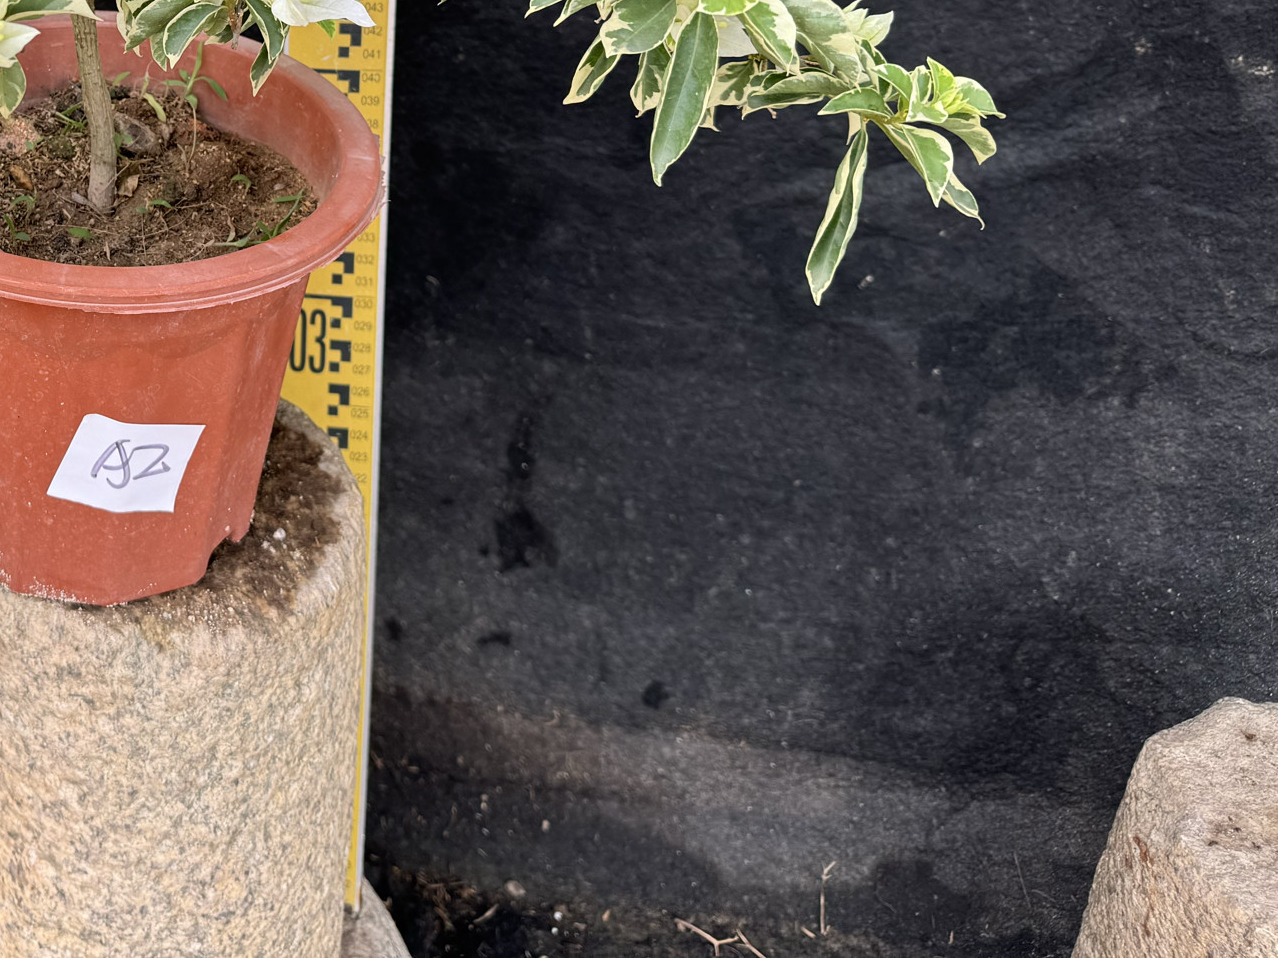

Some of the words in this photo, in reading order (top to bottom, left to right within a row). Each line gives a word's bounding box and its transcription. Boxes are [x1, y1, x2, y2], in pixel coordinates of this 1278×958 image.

[365, 2, 384, 13] 043
[363, 25, 383, 36] 042
[362, 49, 381, 59] 041
[361, 72, 381, 83] 040
[361, 96, 380, 106] 039
[355, 254, 374, 264] 032
[355, 276, 373, 286] 031
[354, 298, 373, 309] 030
[354, 320, 372, 330] 029
[290, 309, 326, 373] 03
[352, 343, 371, 353] 028
[352, 364, 370, 375] 027
[351, 386, 370, 396] 026
[350, 408, 369, 418] 025
[350, 430, 368, 441] 024
[349, 451, 368, 462] 023
